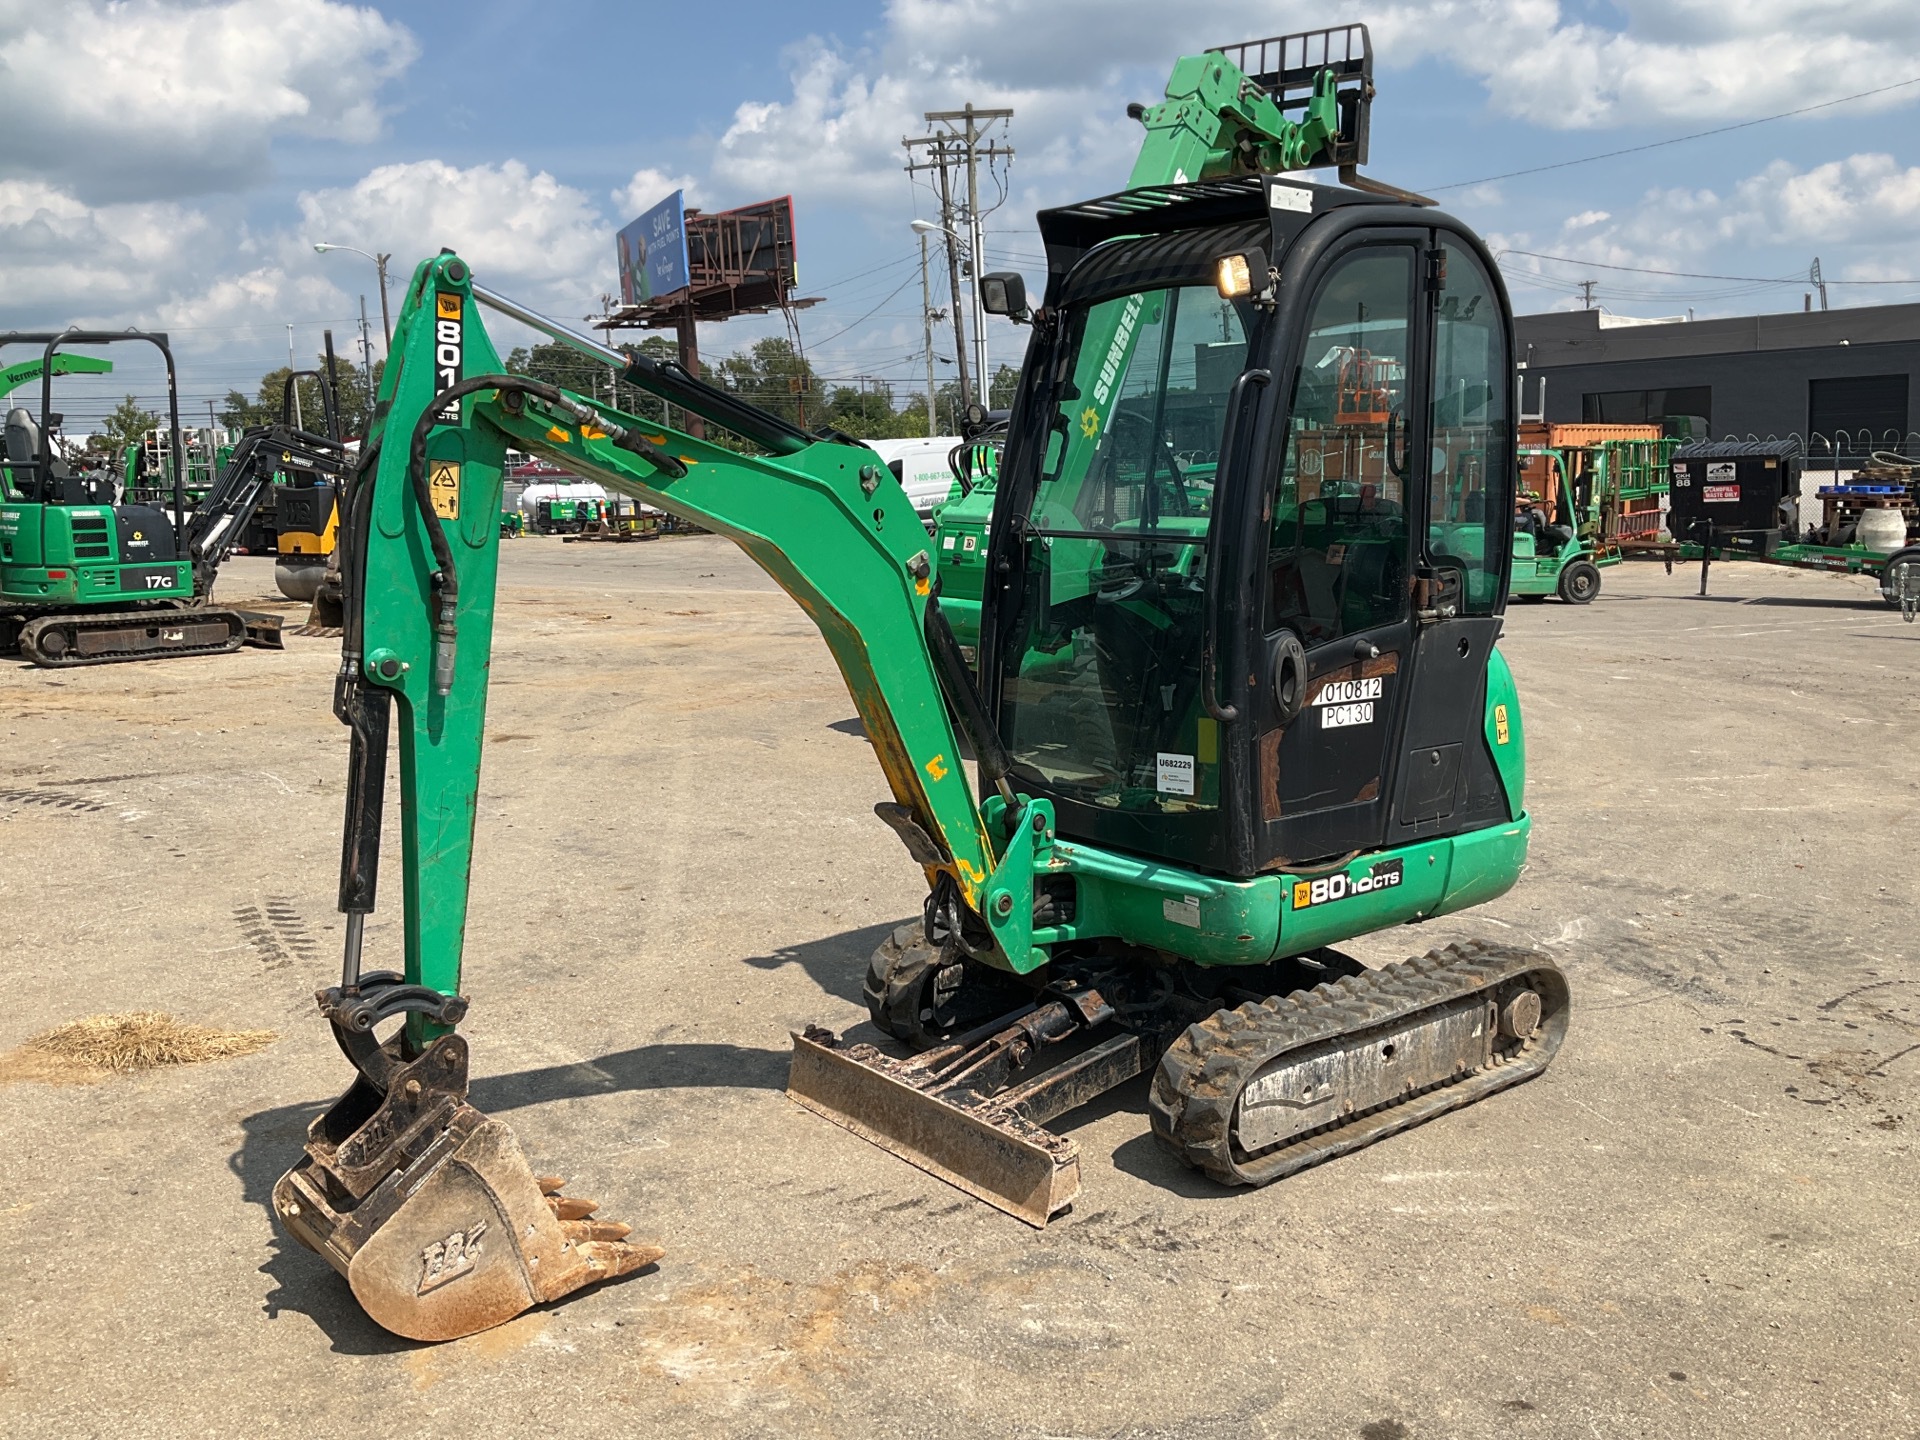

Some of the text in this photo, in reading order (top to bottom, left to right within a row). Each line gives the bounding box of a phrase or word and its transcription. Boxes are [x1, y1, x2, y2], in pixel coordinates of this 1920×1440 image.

[653, 208, 671, 237] SAVE
[656, 236, 667, 249] FUEL
[666, 228, 680, 243] POINTS
[6, 367, 44, 383] Vermee
[1676, 479, 1691, 487] 88
[919, 496, 945, 507] Service
[145, 575, 173, 589] 17G
[1326, 703, 1373, 726] PC130
[1159, 759, 1192, 769] U682229
